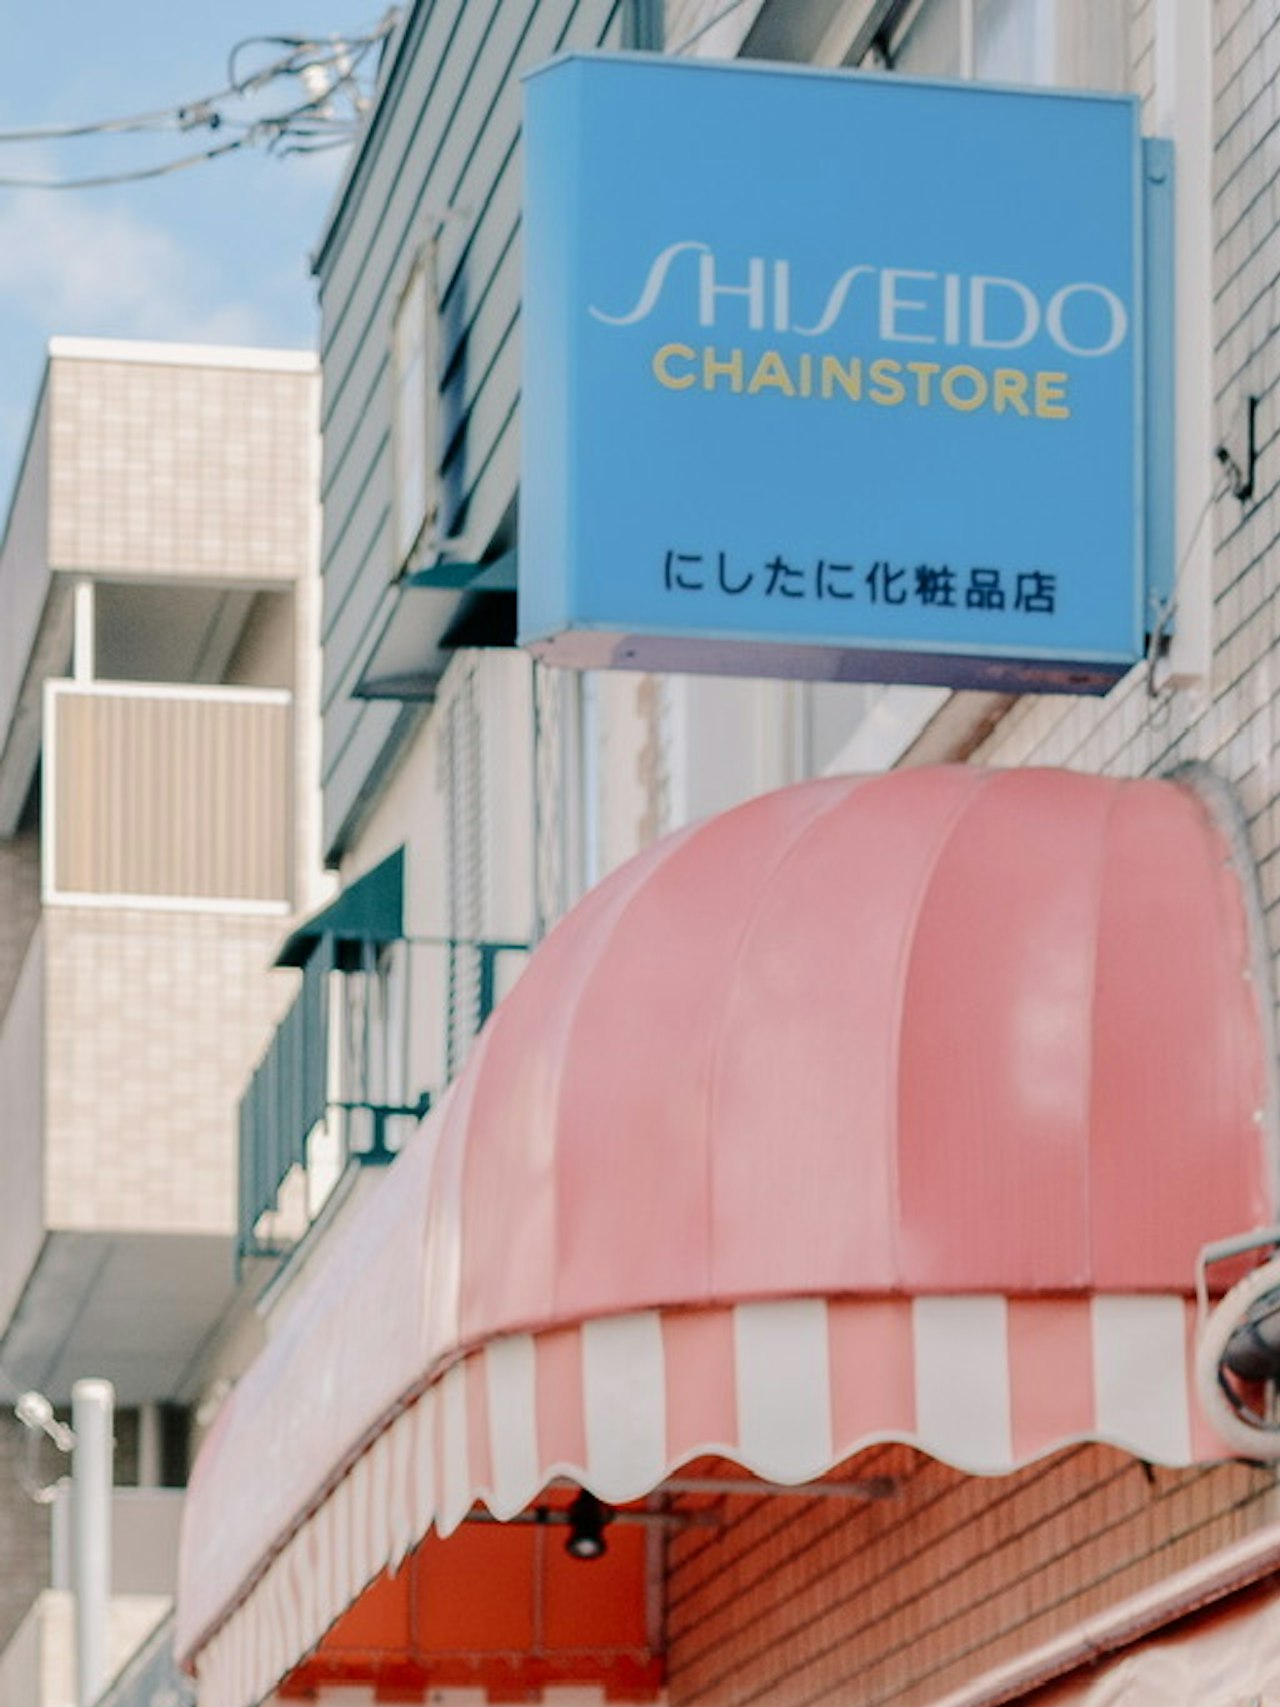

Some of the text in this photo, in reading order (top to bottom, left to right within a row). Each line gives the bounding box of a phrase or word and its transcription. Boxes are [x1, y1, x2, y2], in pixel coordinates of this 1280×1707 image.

[588, 241, 1128, 357] SHISEIDO
[651, 344, 1071, 419] CHAINSTORE
[663, 549, 1057, 615] にしたに化粧品店
